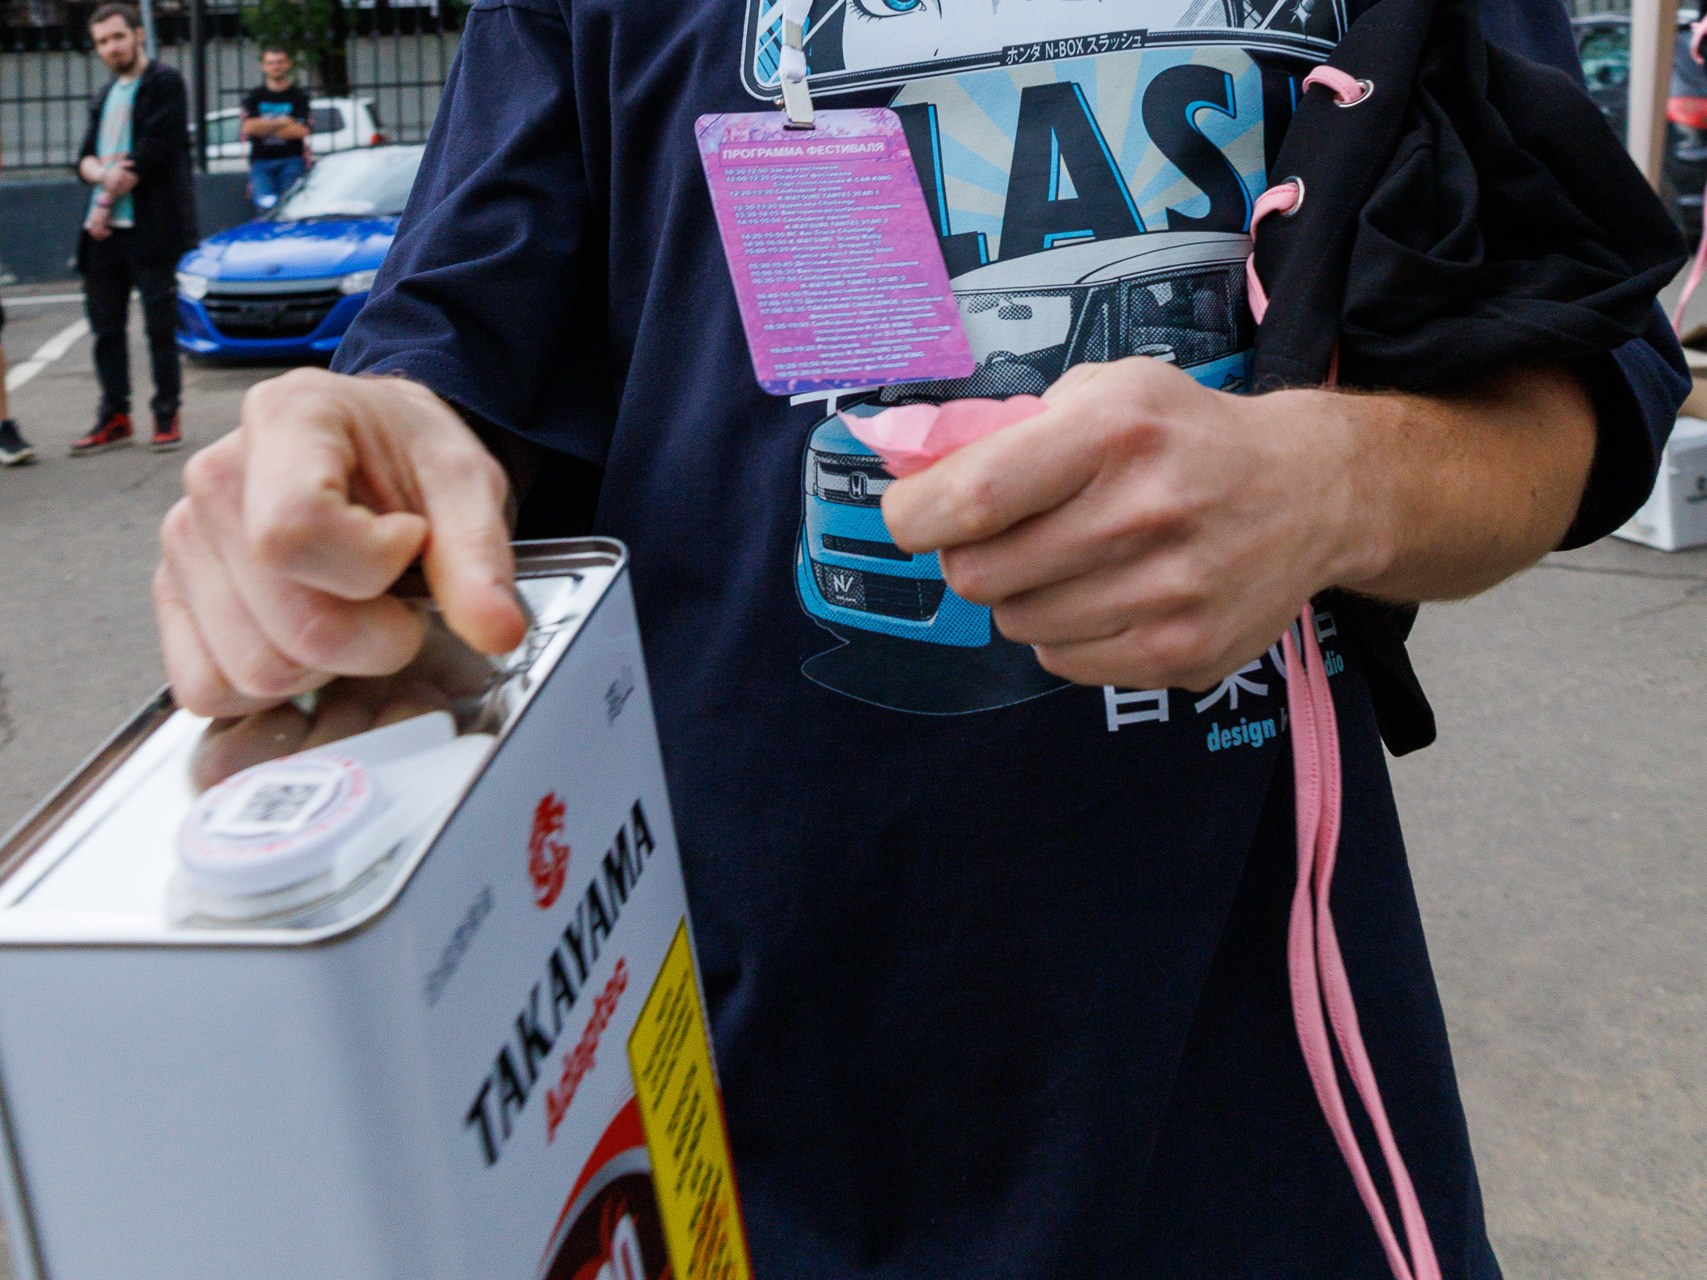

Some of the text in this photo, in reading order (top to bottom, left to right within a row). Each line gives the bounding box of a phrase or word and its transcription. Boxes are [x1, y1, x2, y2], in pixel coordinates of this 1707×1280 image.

[1006, 32, 1142, 65] ホンダ N-BOX スラッシュ
[722, 141, 885, 160] ПРОГРАММА ФЕСТИВАЛЯ
[892, 63, 1296, 278] LAS
[1206, 717, 1277, 752] design
[465, 797, 657, 1167] TAKAYAMA
